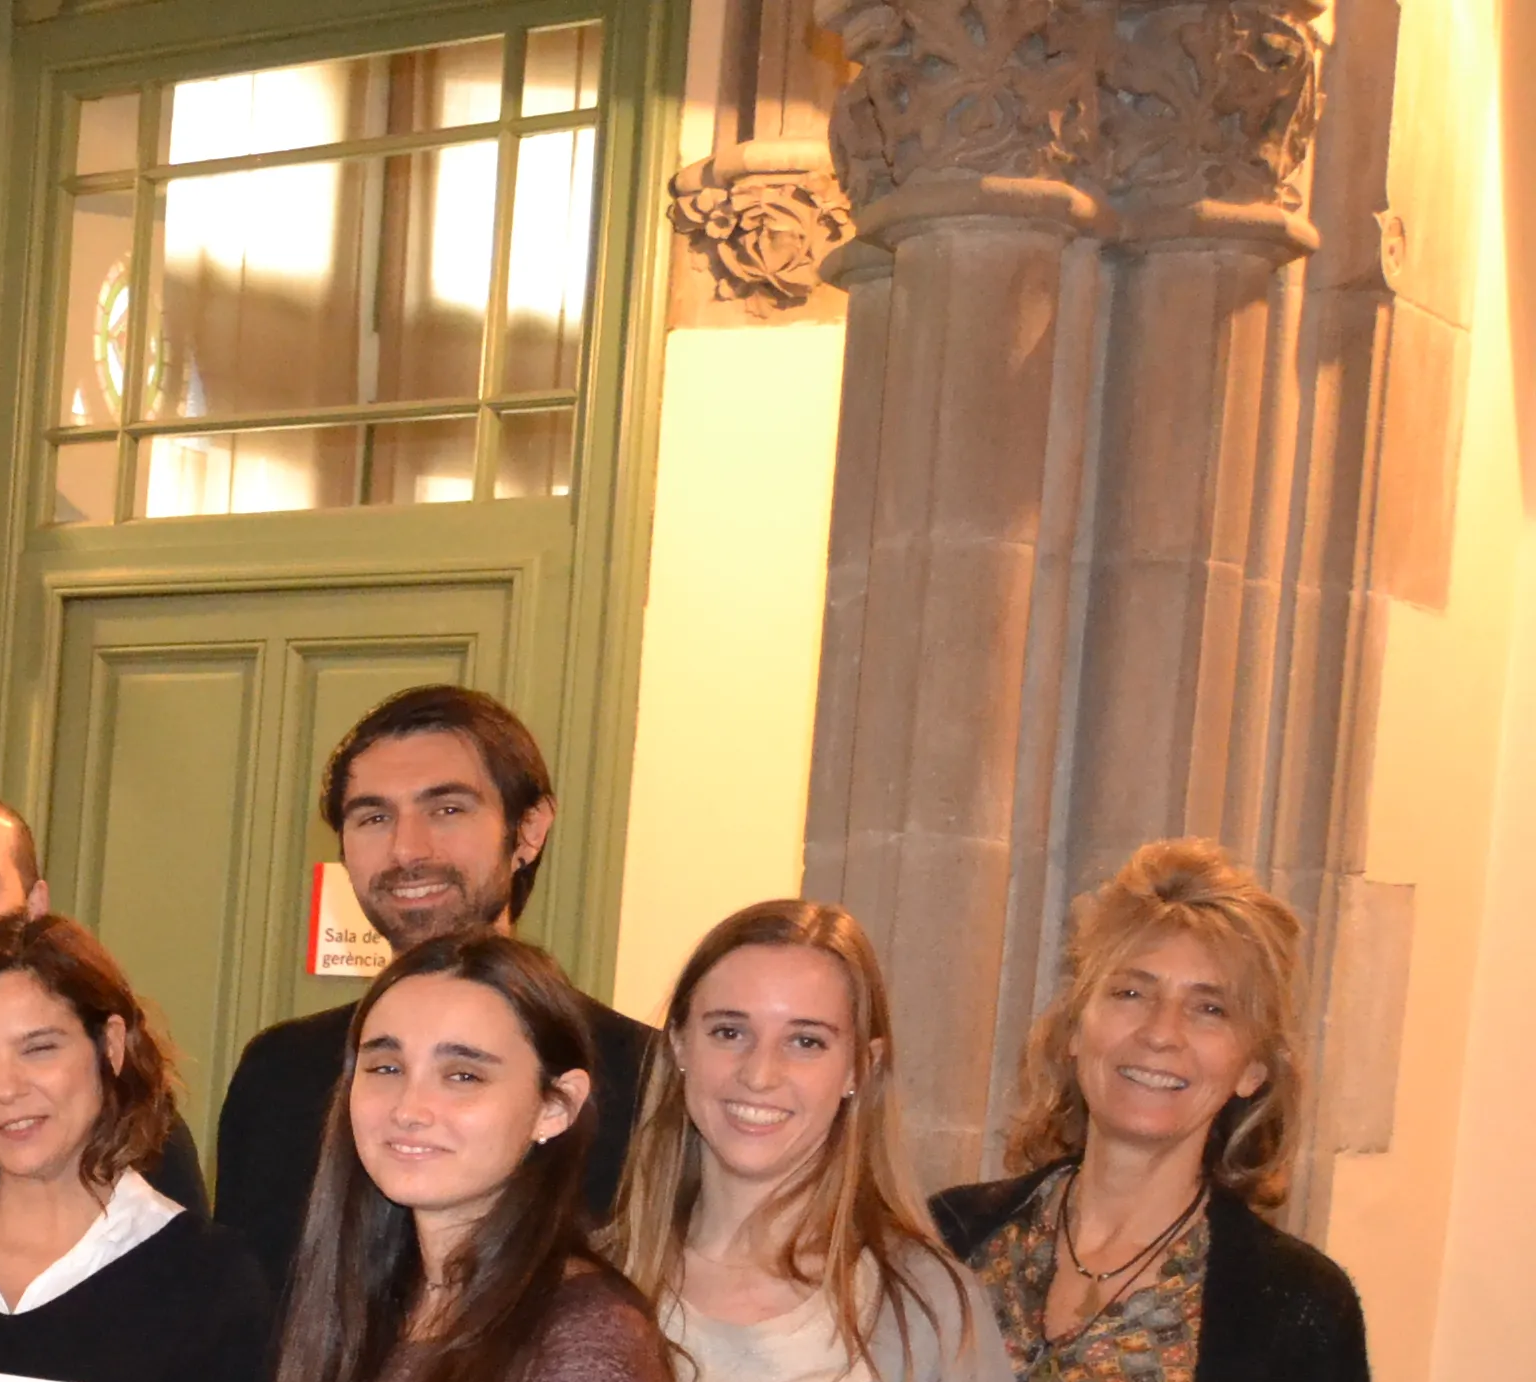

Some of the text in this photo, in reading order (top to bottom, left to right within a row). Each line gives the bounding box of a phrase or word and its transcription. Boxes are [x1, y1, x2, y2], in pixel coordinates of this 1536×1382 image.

[325, 928, 381, 944] Sala de
[322, 952, 386, 968] gerència
